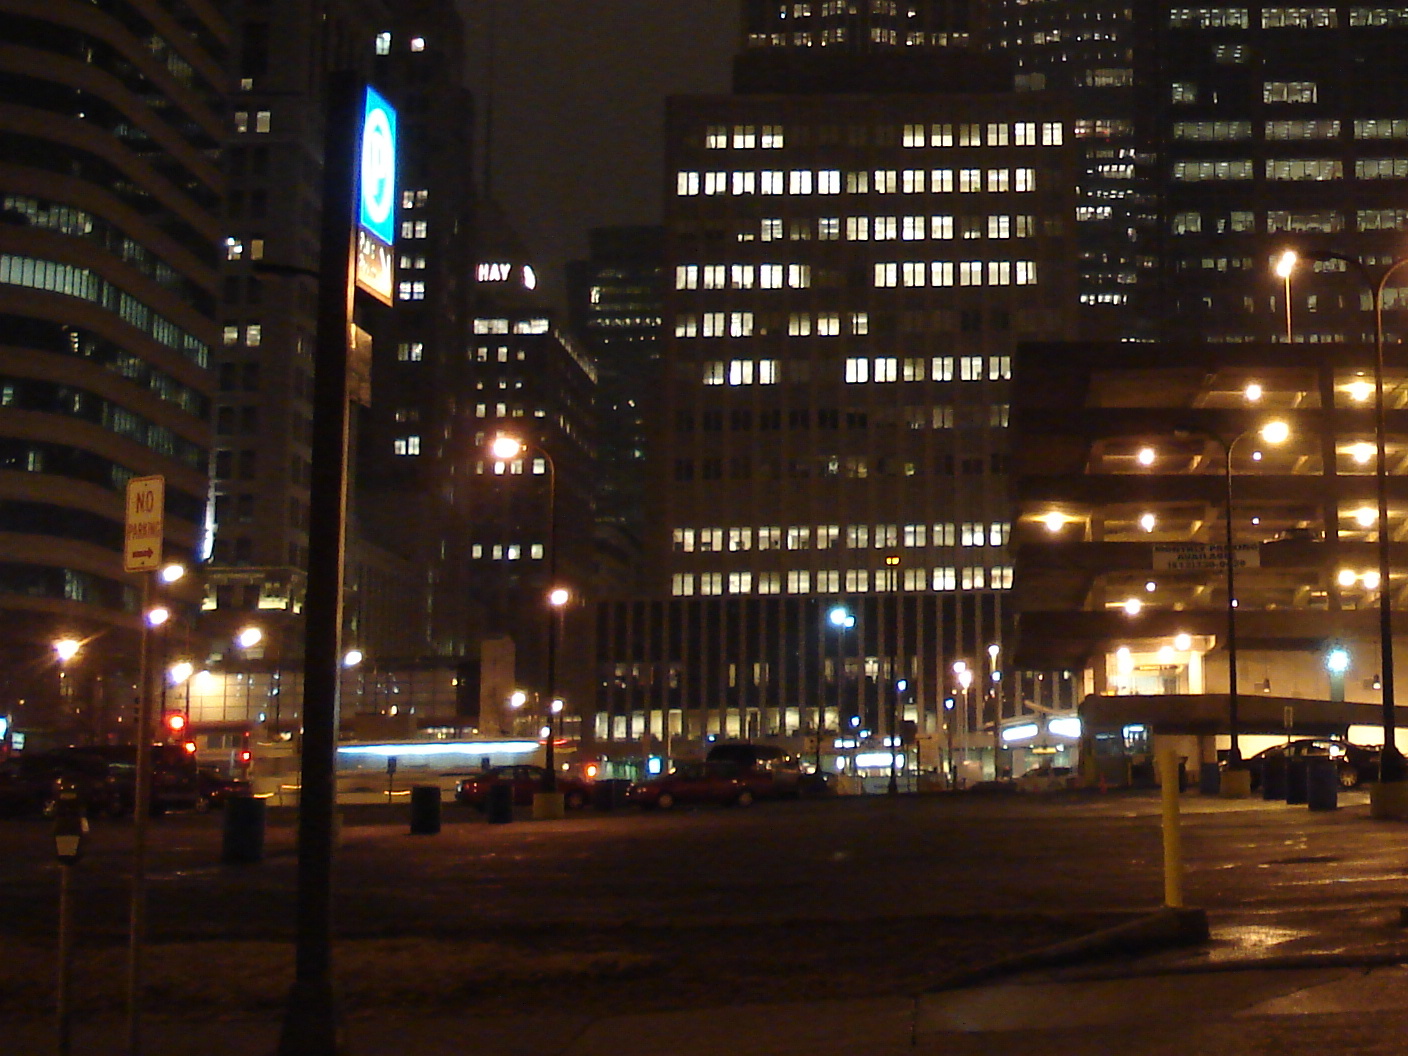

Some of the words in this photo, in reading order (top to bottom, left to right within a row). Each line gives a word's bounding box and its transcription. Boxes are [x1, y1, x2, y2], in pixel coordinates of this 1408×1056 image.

[478, 262, 511, 282] HAY
[136, 490, 154, 513] NO
[127, 522, 160, 541] PARKING
[1209, 544, 1258, 552] PARING
